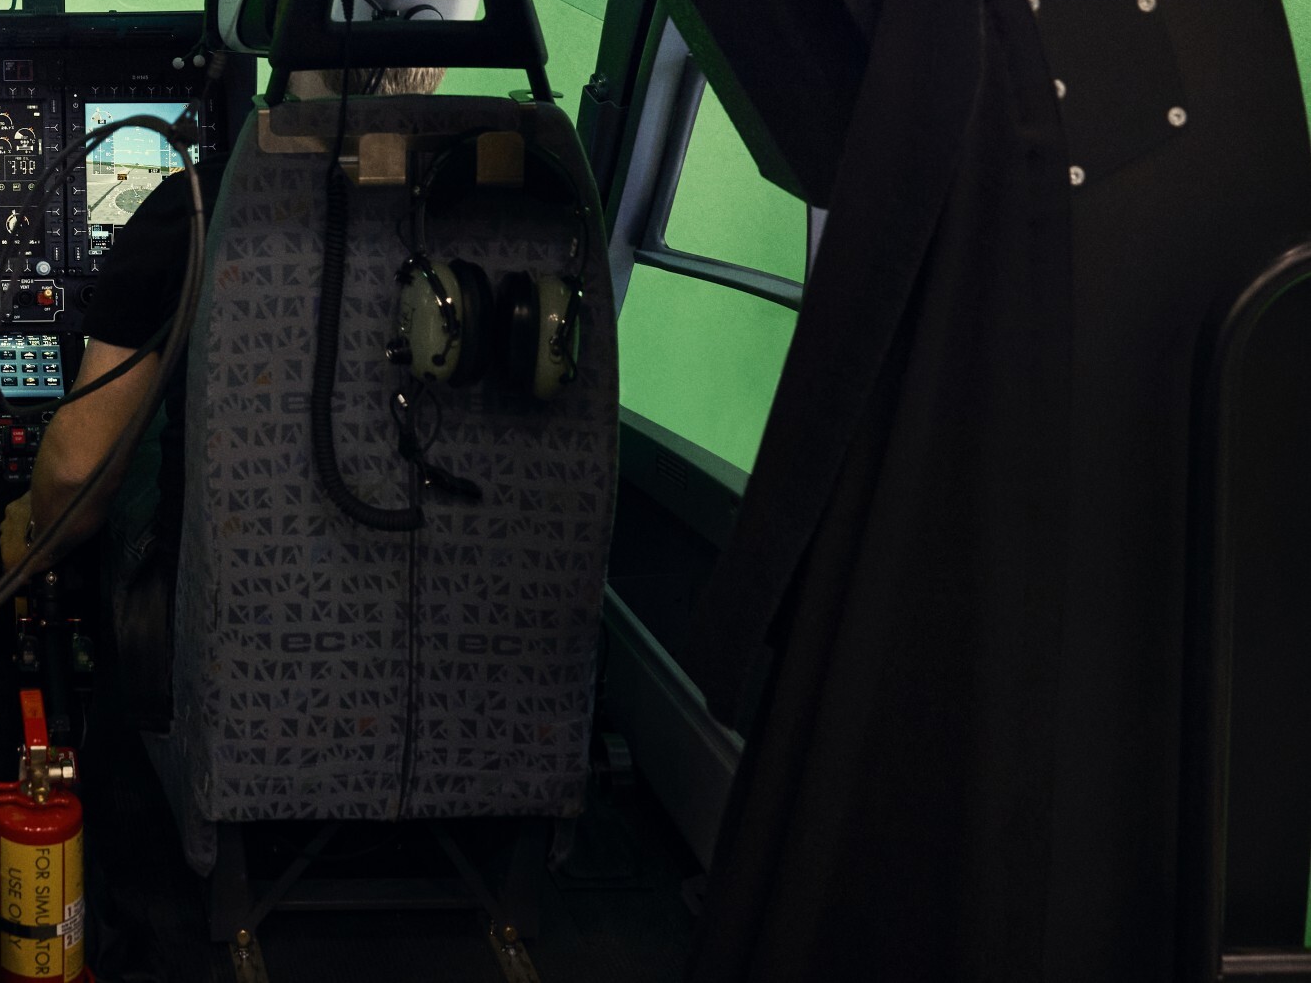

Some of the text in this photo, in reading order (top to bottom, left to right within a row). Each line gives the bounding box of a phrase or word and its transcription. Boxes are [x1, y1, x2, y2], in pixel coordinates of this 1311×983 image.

[8, 867, 22, 950] USE OY
[34, 847, 51, 975] FOR SIMUTOR
